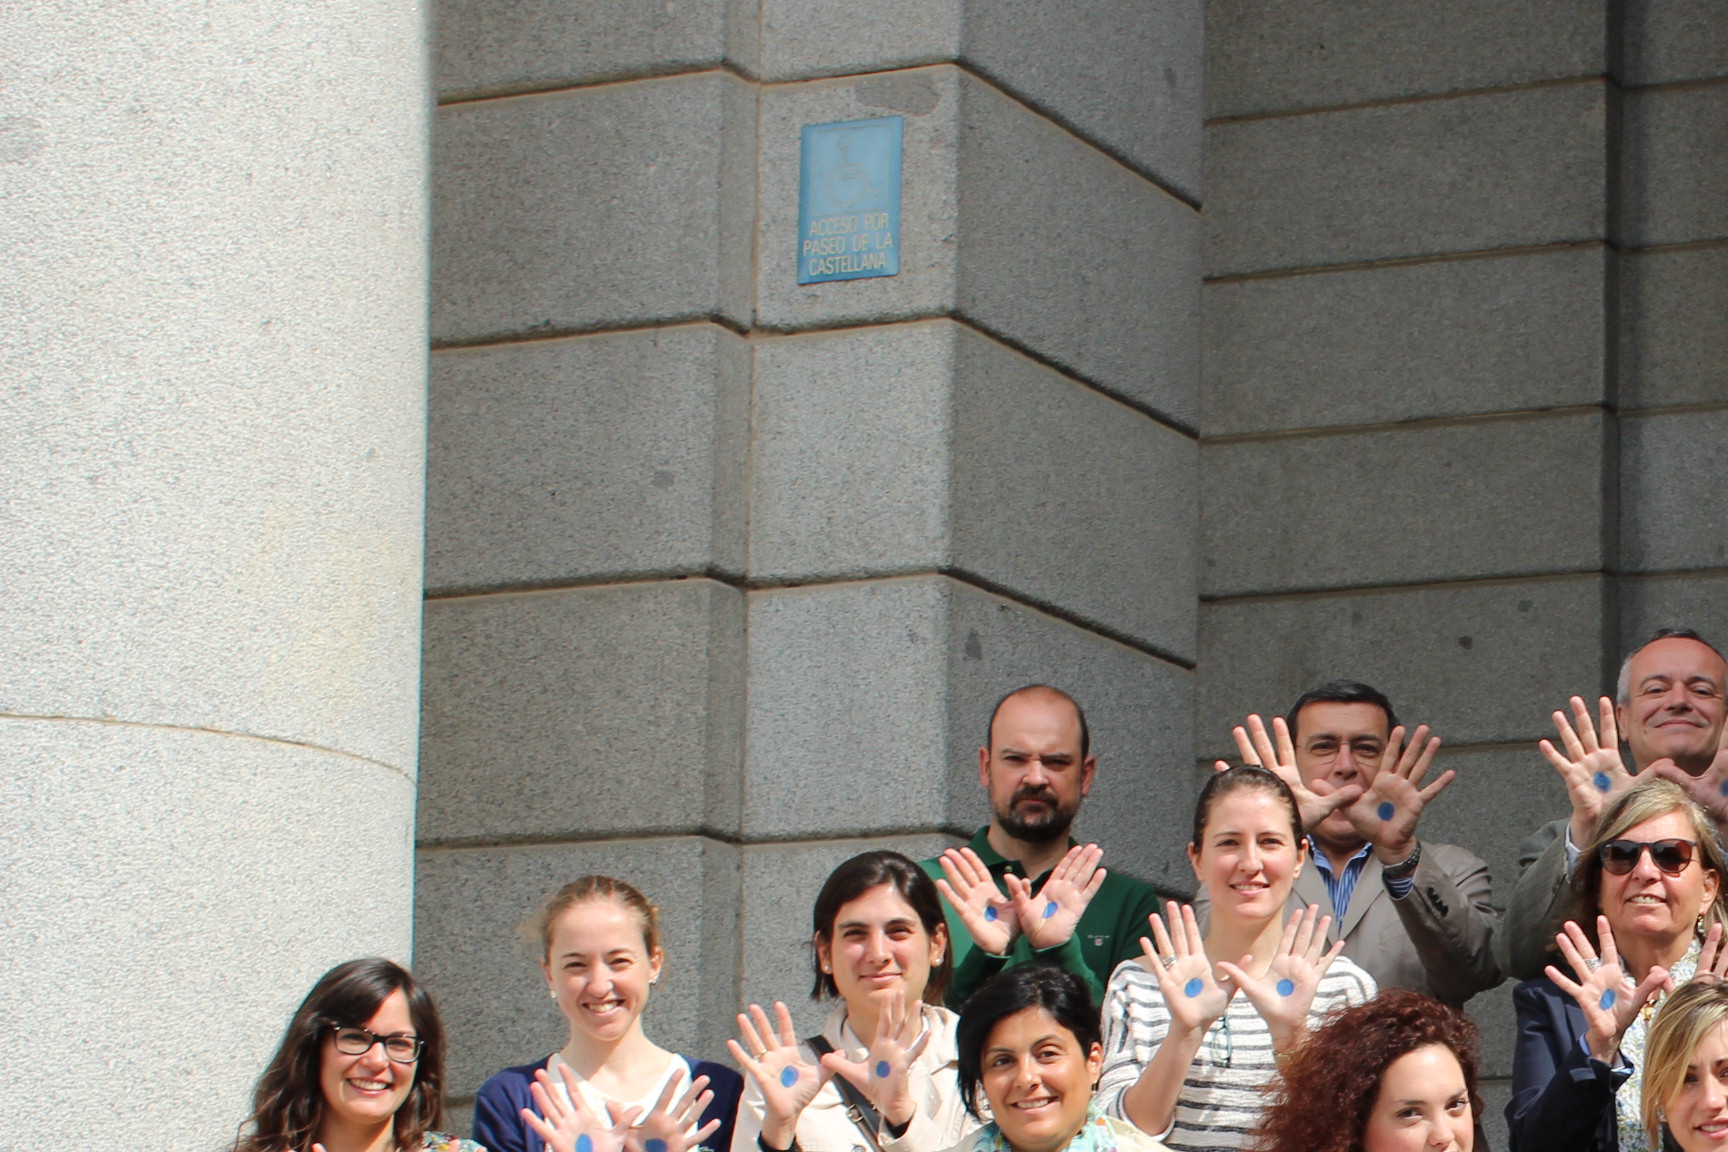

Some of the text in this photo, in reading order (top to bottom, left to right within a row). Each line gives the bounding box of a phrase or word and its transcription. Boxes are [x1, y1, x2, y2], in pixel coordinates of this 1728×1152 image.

[810, 212, 889, 236] ACCESO POR
[804, 232, 893, 256] PASEO DE LA
[810, 253, 886, 275] CASTELLANA
